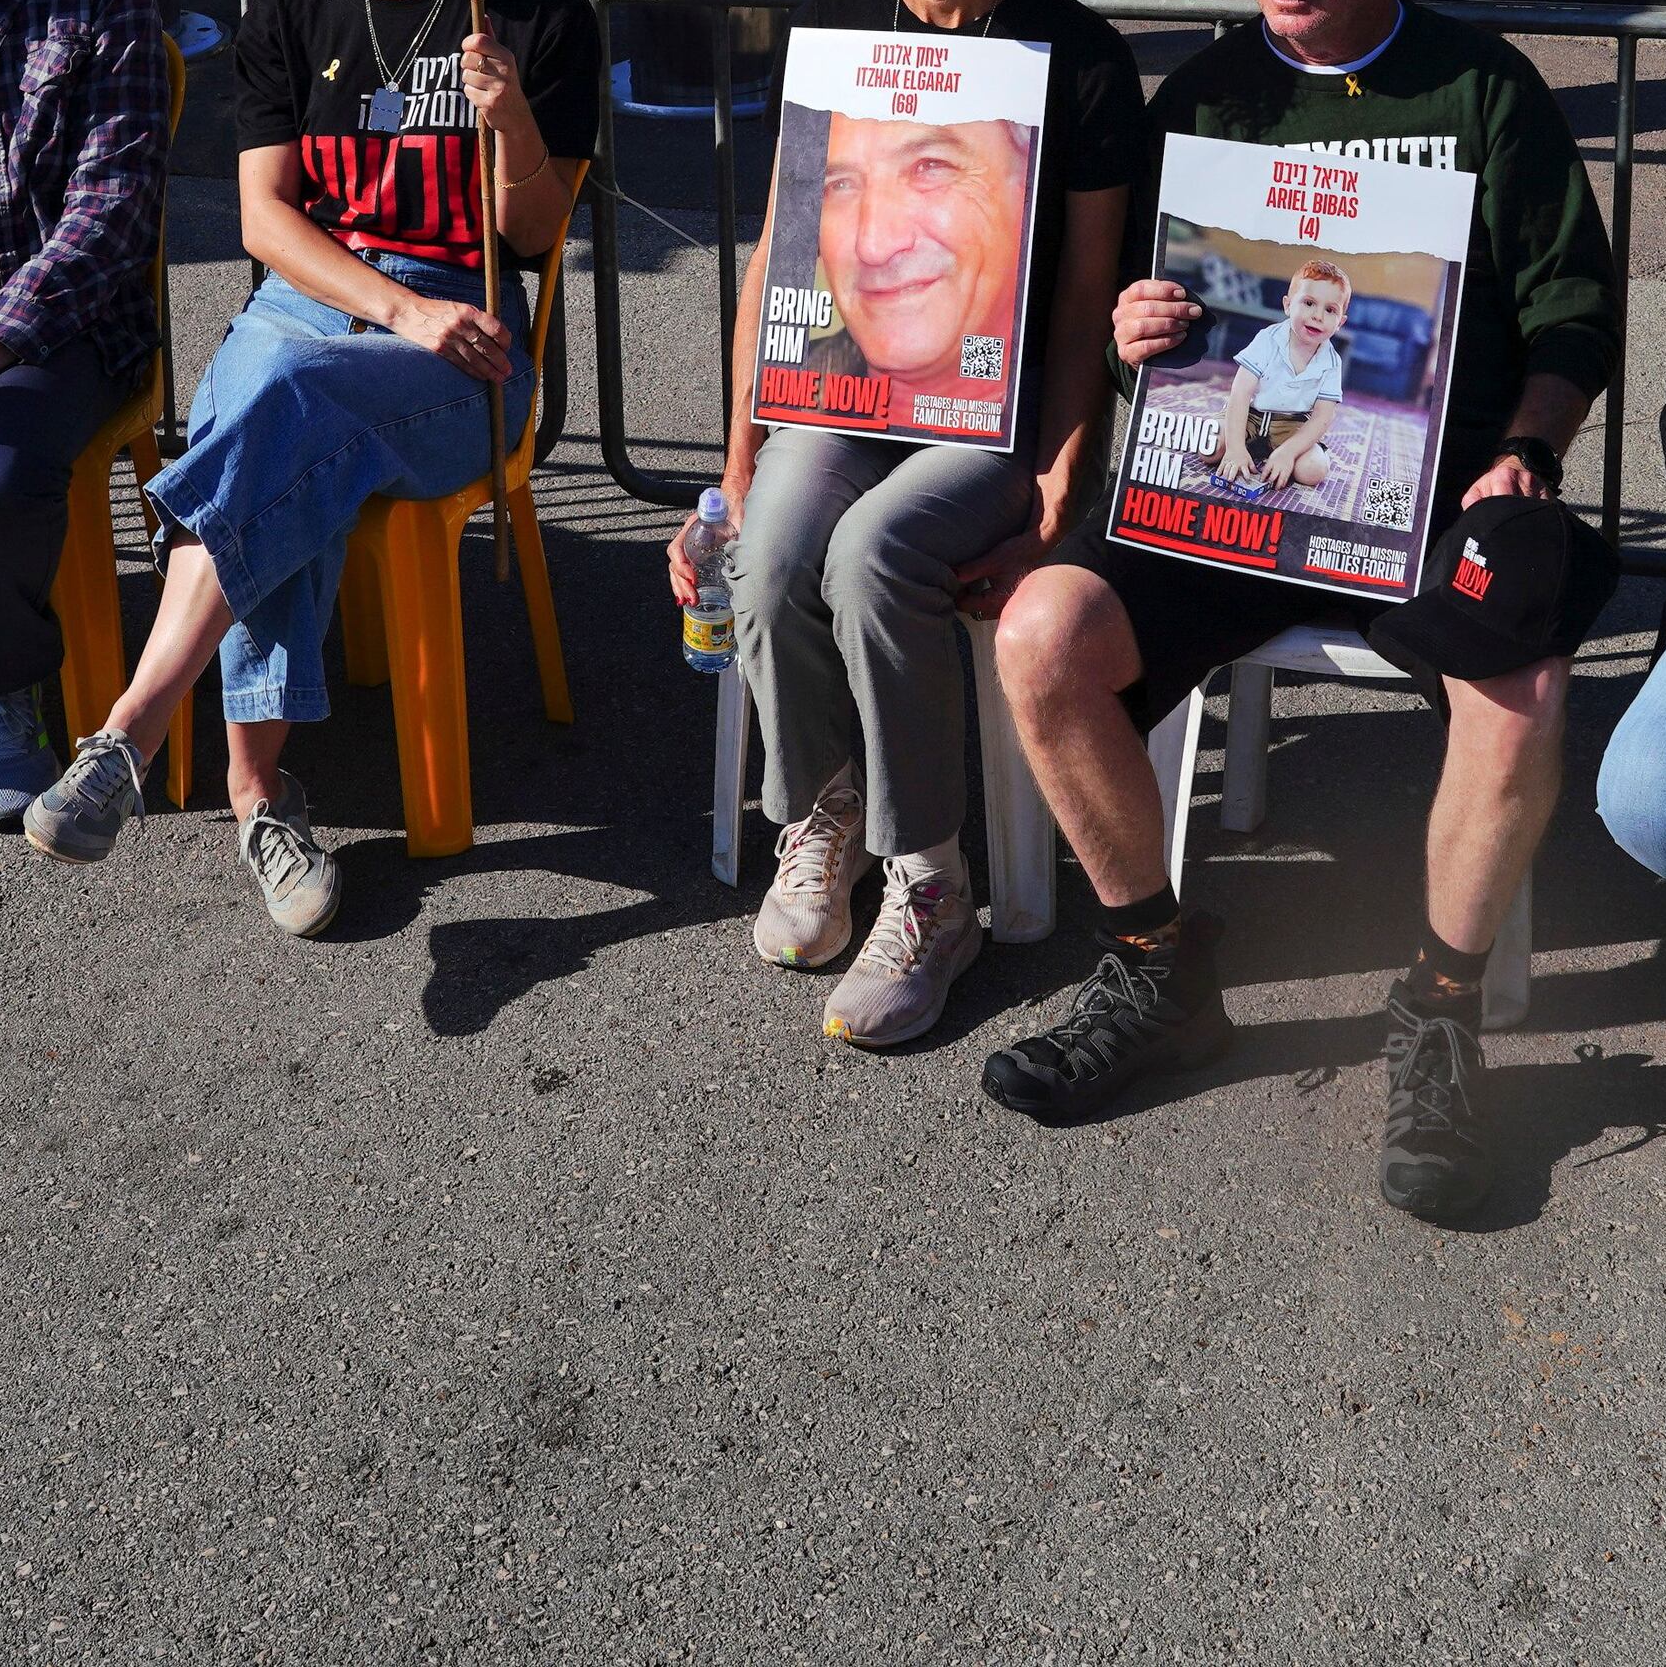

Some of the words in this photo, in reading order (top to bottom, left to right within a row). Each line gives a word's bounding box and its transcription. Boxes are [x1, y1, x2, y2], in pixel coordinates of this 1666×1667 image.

[872, 43, 912, 65] אלגרט
[916, 46, 949, 68] יצחק
[856, 69, 900, 90] ITZHAK
[902, 71, 962, 93] ELGARAT
[891, 93, 918, 115] (68)
[1272, 161, 1308, 185] ביבס
[1312, 164, 1359, 193] אריאל
[1265, 187, 1309, 213] ARIEL
[1312, 192, 1359, 219] BIBAS
[1298, 216, 1320, 242] (4)
[768, 286, 833, 327] BRING
[764, 324, 807, 364] HIM
[760, 367, 821, 409] HOME
[822, 373, 892, 416] NOW!
[913, 394, 951, 411] HOSTAGES
[952, 397, 967, 411] AND
[968, 399, 1002, 415] MISSING
[912, 406, 960, 430] FAMILIES
[961, 411, 1002, 433] FORUM
[1137, 407, 1221, 457] BRING
[1129, 446, 1184, 490] HIM
[1122, 487, 1200, 537] HOME
[1203, 502, 1283, 555] NOW!
[1308, 535, 1351, 557] HOSTAGES
[1352, 543, 1369, 559] AND
[1370, 545, 1407, 564] MISSING
[1305, 548, 1361, 576] FAMILIES
[1361, 558, 1405, 583] FORUM
[1455, 558, 1493, 596] NOW
